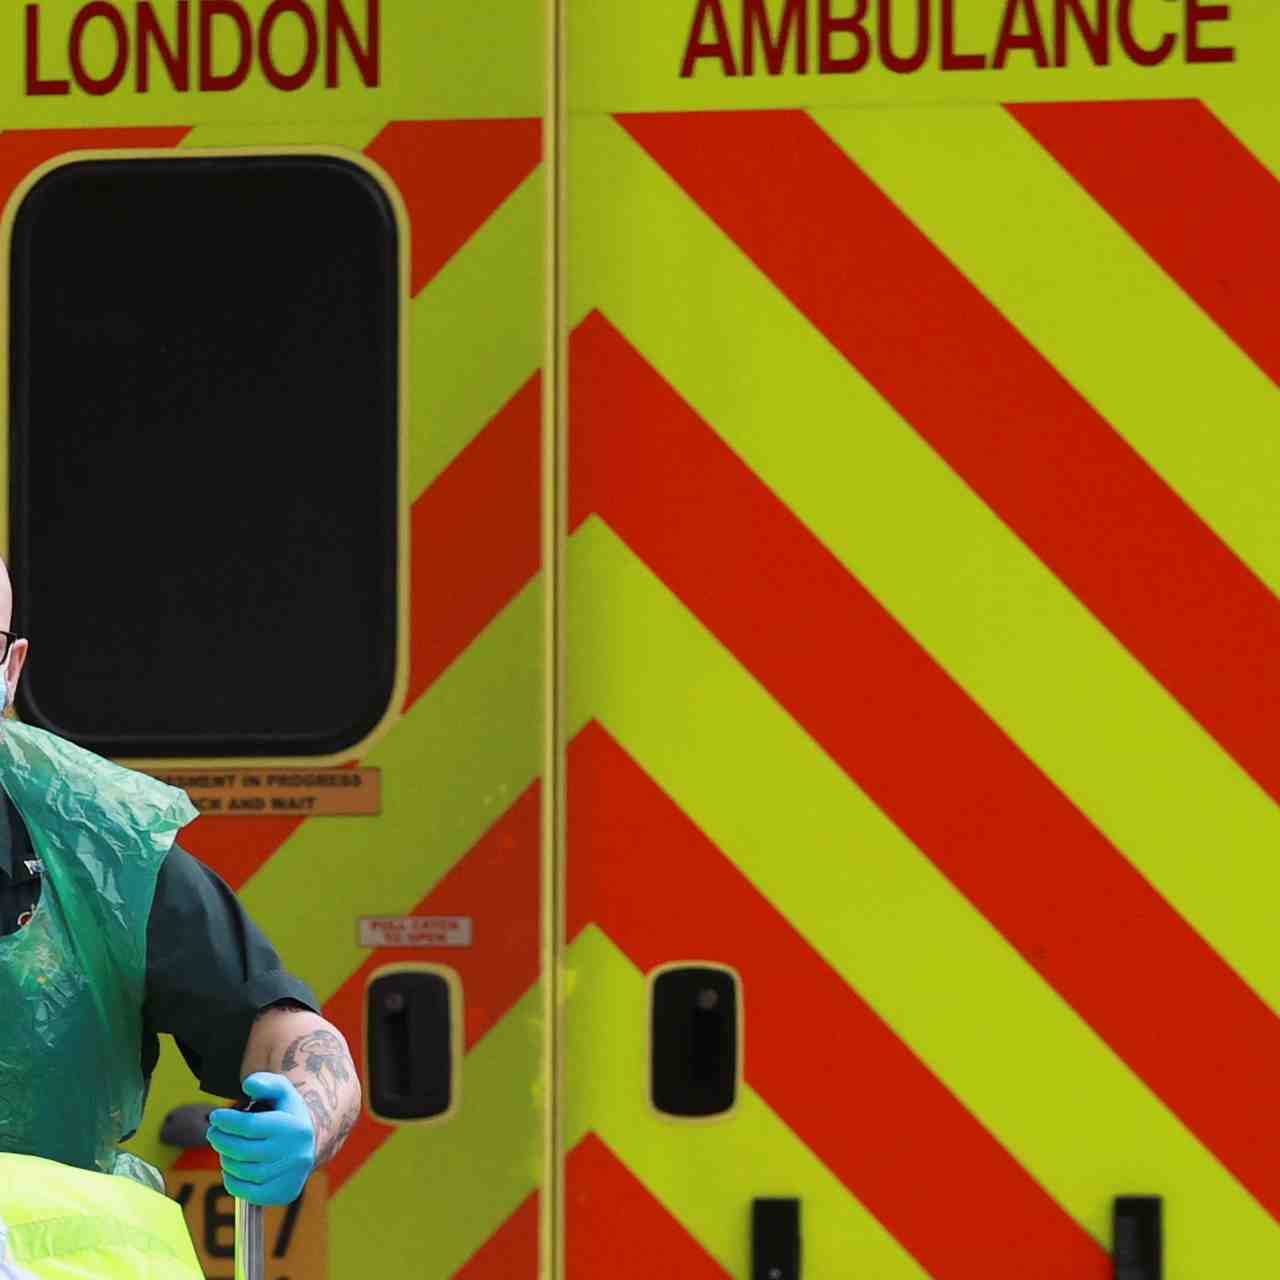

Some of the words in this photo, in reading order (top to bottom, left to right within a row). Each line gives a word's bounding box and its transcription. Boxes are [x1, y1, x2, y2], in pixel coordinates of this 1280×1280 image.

[25, 0, 381, 96] LONDON
[679, 0, 1236, 78] AMBULANCE
[228, 797, 266, 811] AND
[270, 797, 317, 811] WAIT
[241, 774, 261, 788] IN
[266, 774, 362, 788] PROGRESS
